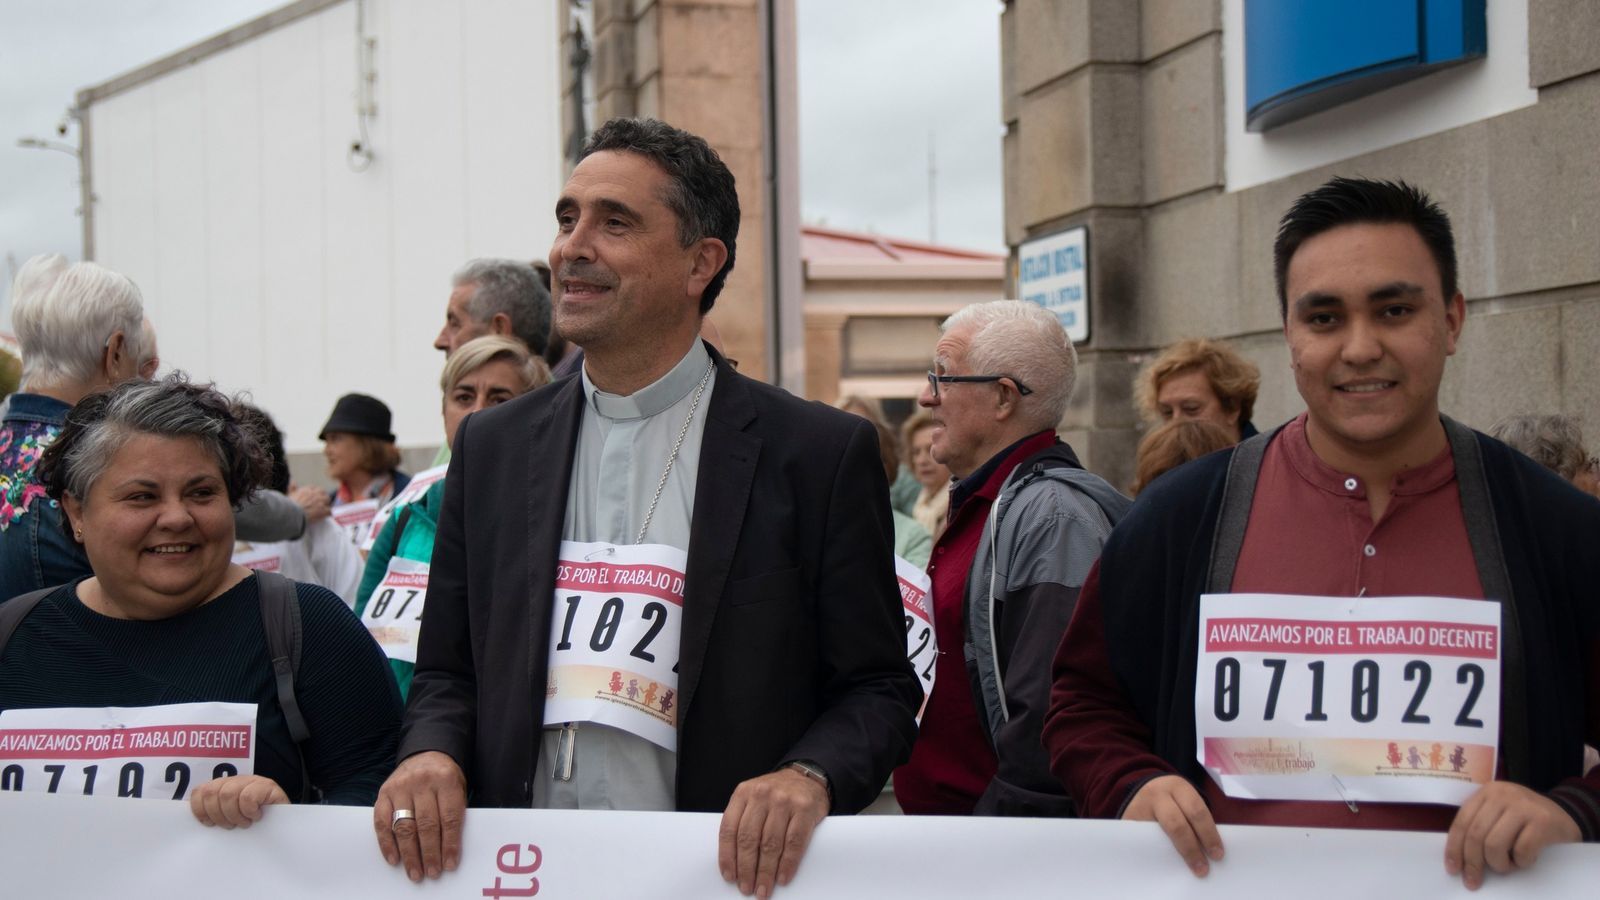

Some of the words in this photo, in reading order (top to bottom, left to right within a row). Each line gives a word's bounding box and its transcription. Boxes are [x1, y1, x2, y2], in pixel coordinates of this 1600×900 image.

[571, 567, 597, 584] POR
[598, 567, 609, 584] EL
[613, 570, 670, 590] TRABAJO
[371, 588, 423, 621] 07
[556, 595, 680, 674] 102
[1209, 624, 1301, 645] AVANZAMOS
[1305, 626, 1334, 645] POR
[1337, 627, 1353, 646] EL
[1357, 627, 1426, 647] TRABAJO
[1429, 629, 1494, 650] DECENTE
[1213, 656, 1485, 728] 071022
[0, 734, 82, 751] AVANZAMOS
[85, 735, 109, 751] POR
[112, 733, 124, 749] EL
[129, 731, 186, 749] TRABAJO
[189, 730, 247, 749] DECENTE
